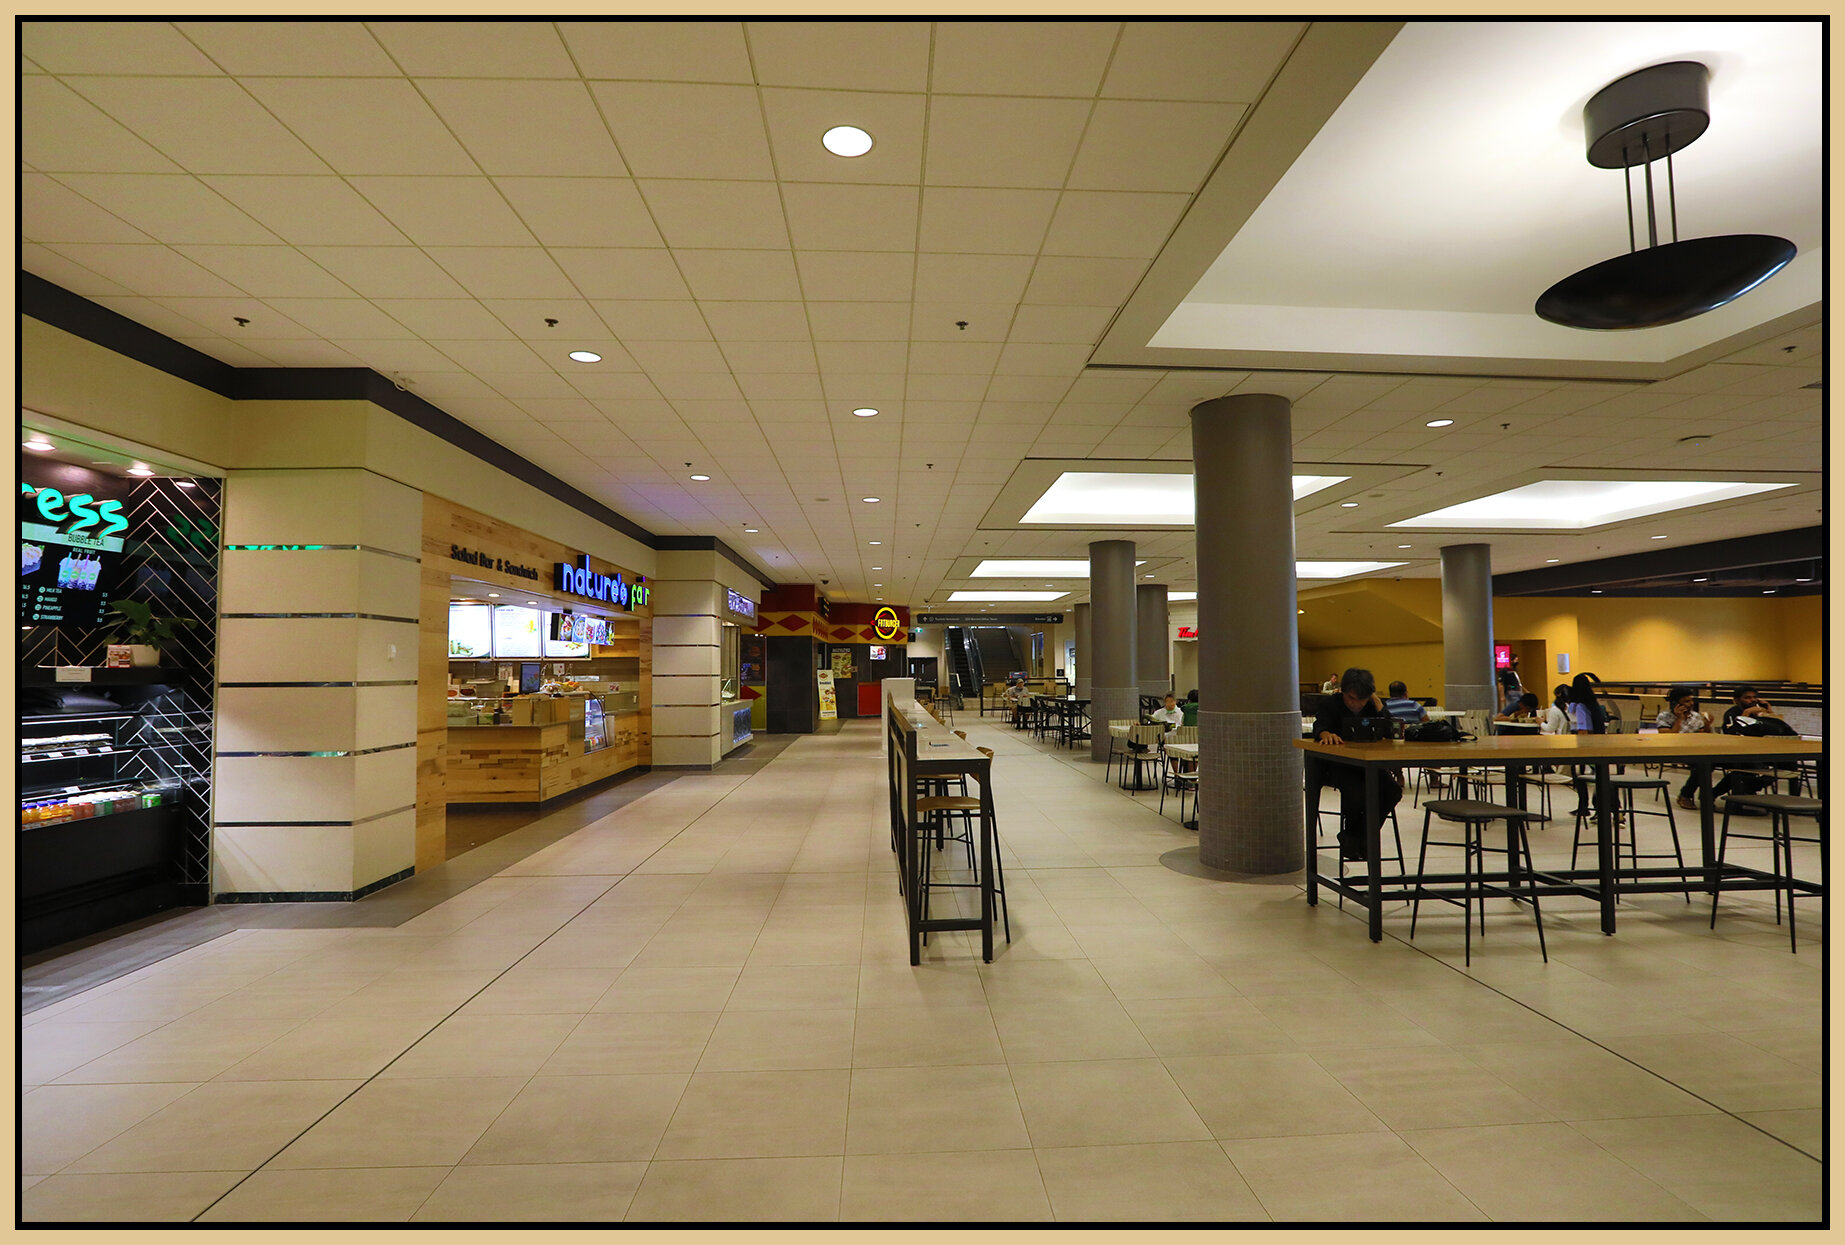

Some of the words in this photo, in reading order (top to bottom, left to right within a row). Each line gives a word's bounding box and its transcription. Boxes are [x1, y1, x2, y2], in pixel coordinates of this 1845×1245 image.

[68, 533, 91, 545] BUBBLE
[93, 539, 105, 547] TEA
[451, 544, 478, 565] Salad
[480, 552, 494, 569] Bar
[497, 559, 503, 572] &
[505, 560, 538, 580] Sandwich
[561, 554, 628, 606] nature's
[631, 576, 650, 612] fair
